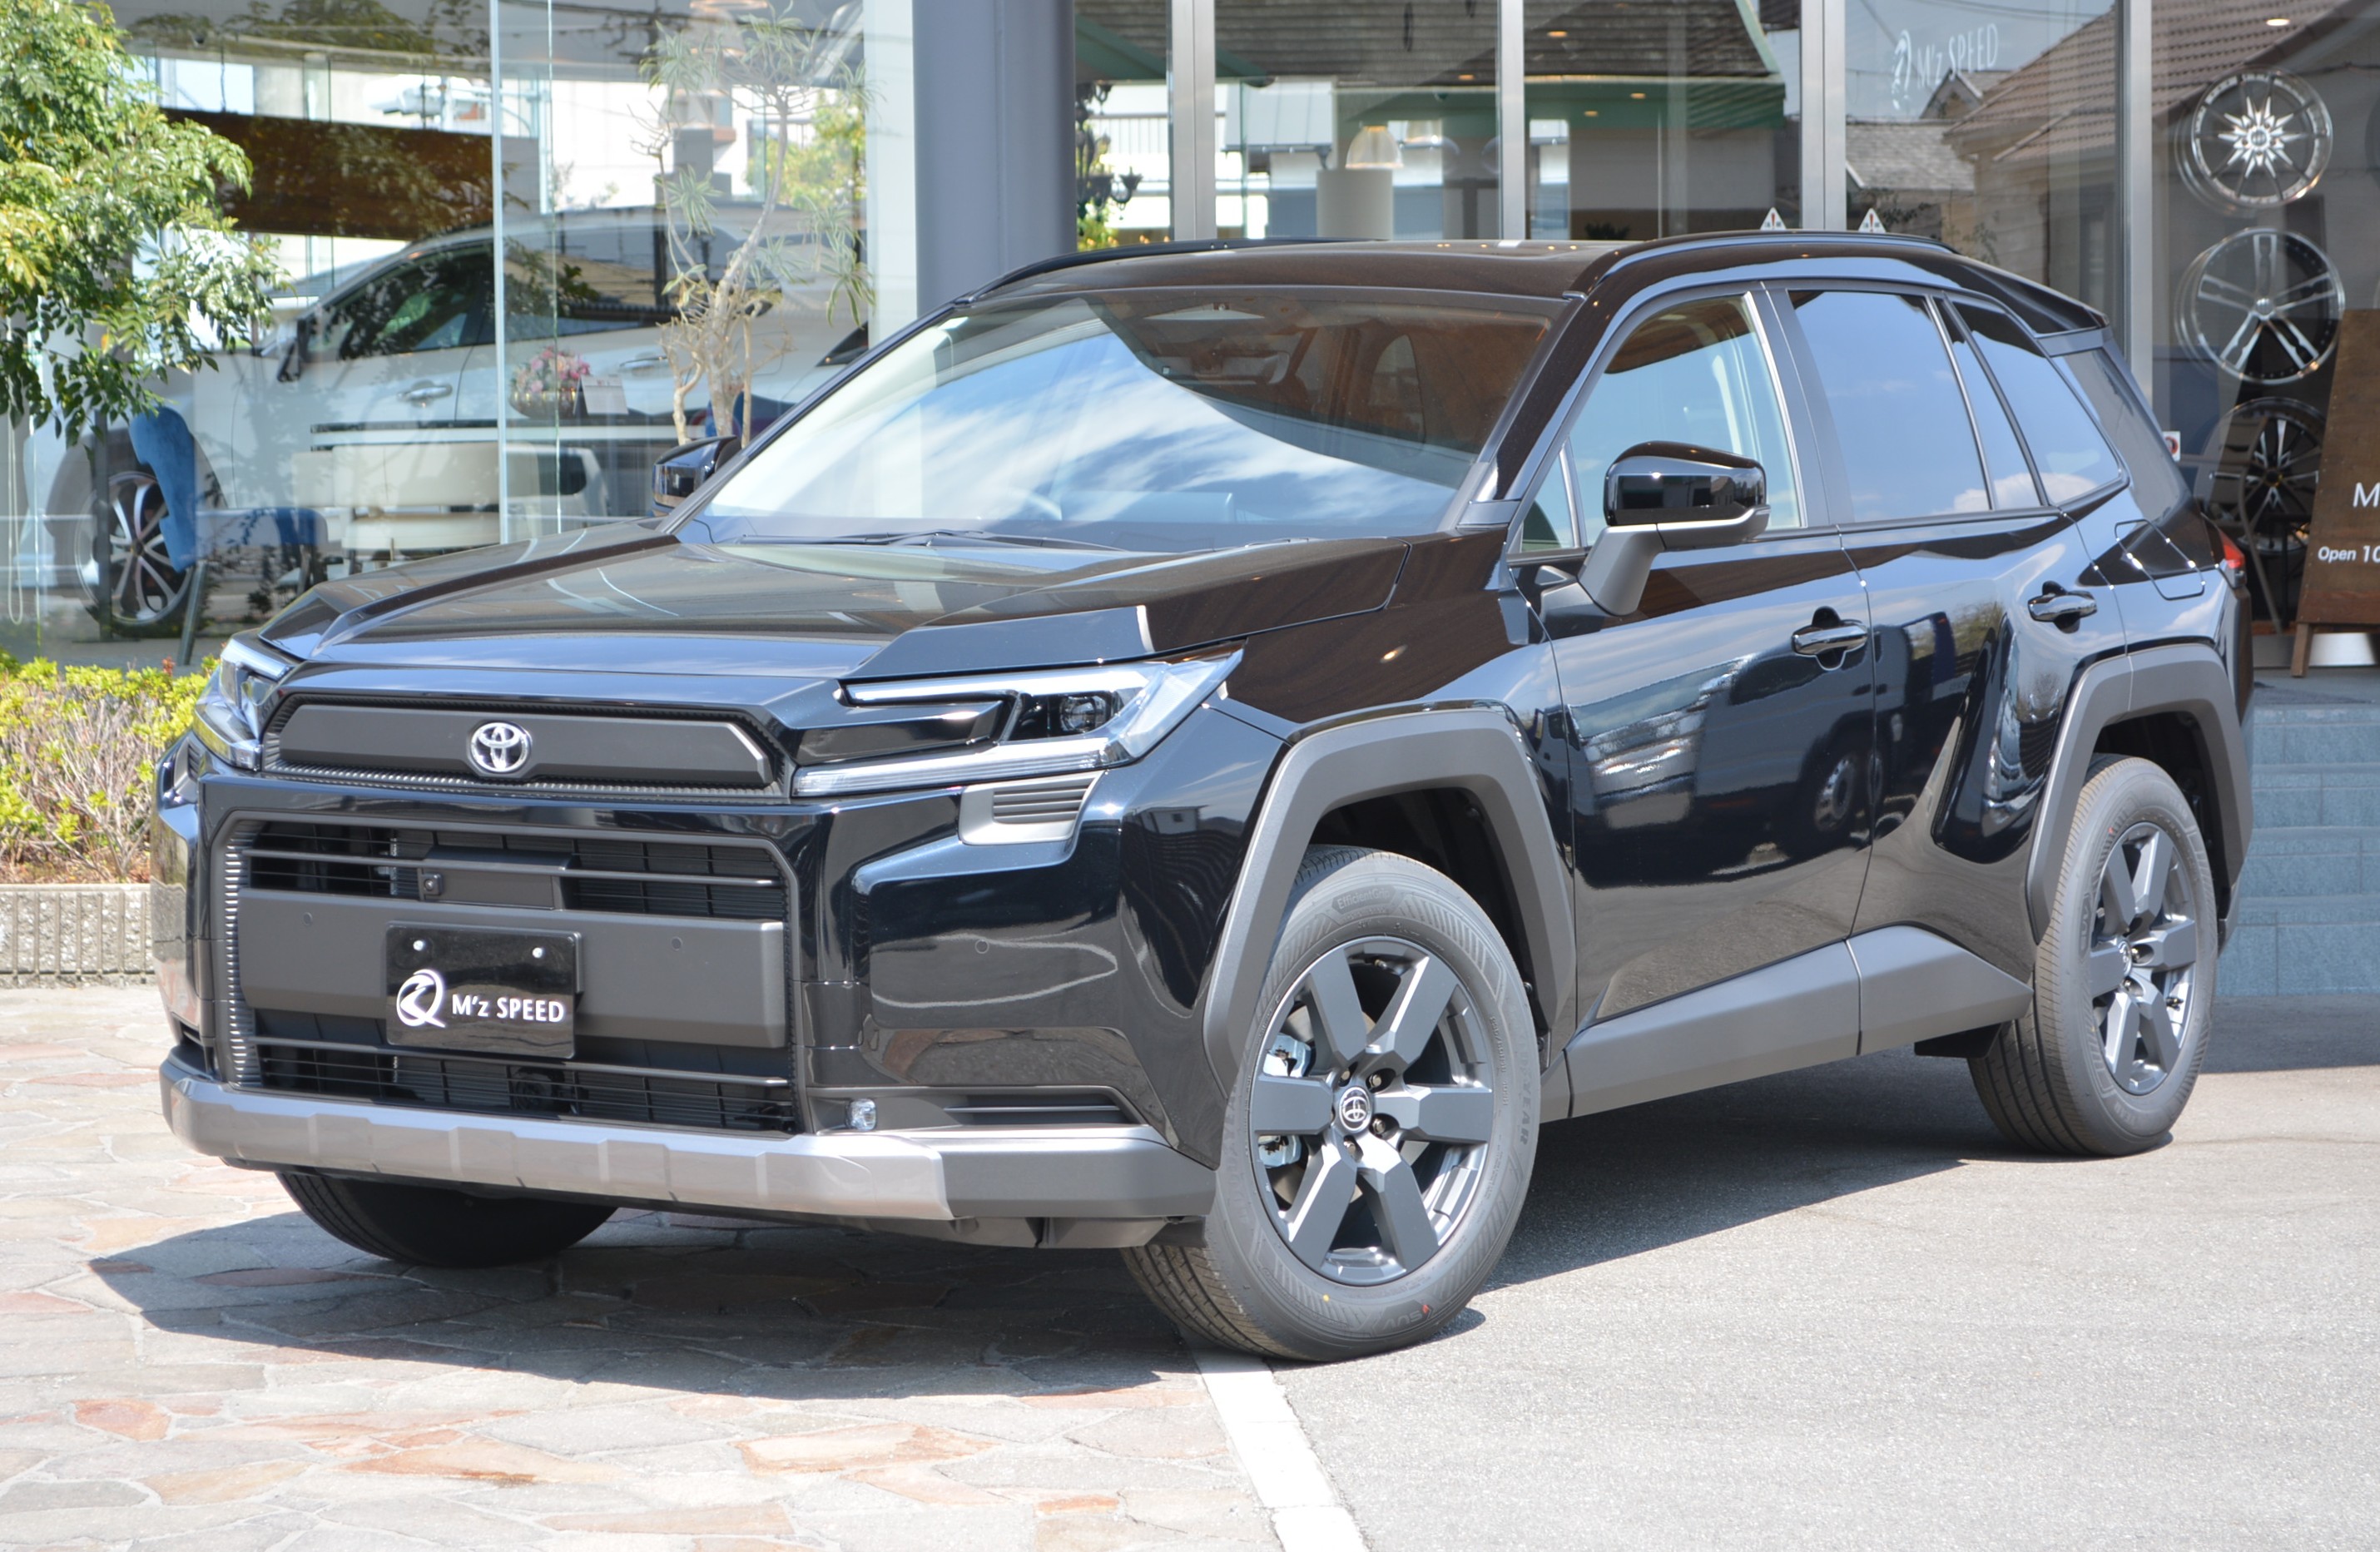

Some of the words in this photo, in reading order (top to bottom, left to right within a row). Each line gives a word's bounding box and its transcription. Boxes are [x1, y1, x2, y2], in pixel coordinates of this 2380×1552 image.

[1948, 22, 1998, 82] SPEED
[2318, 546, 2357, 563] Open
[1336, 888, 1391, 910] EfficientGrip
[452, 994, 489, 1017] M'z
[496, 997, 564, 1023] SPEED
[1383, 1310, 1422, 1330] SUV
